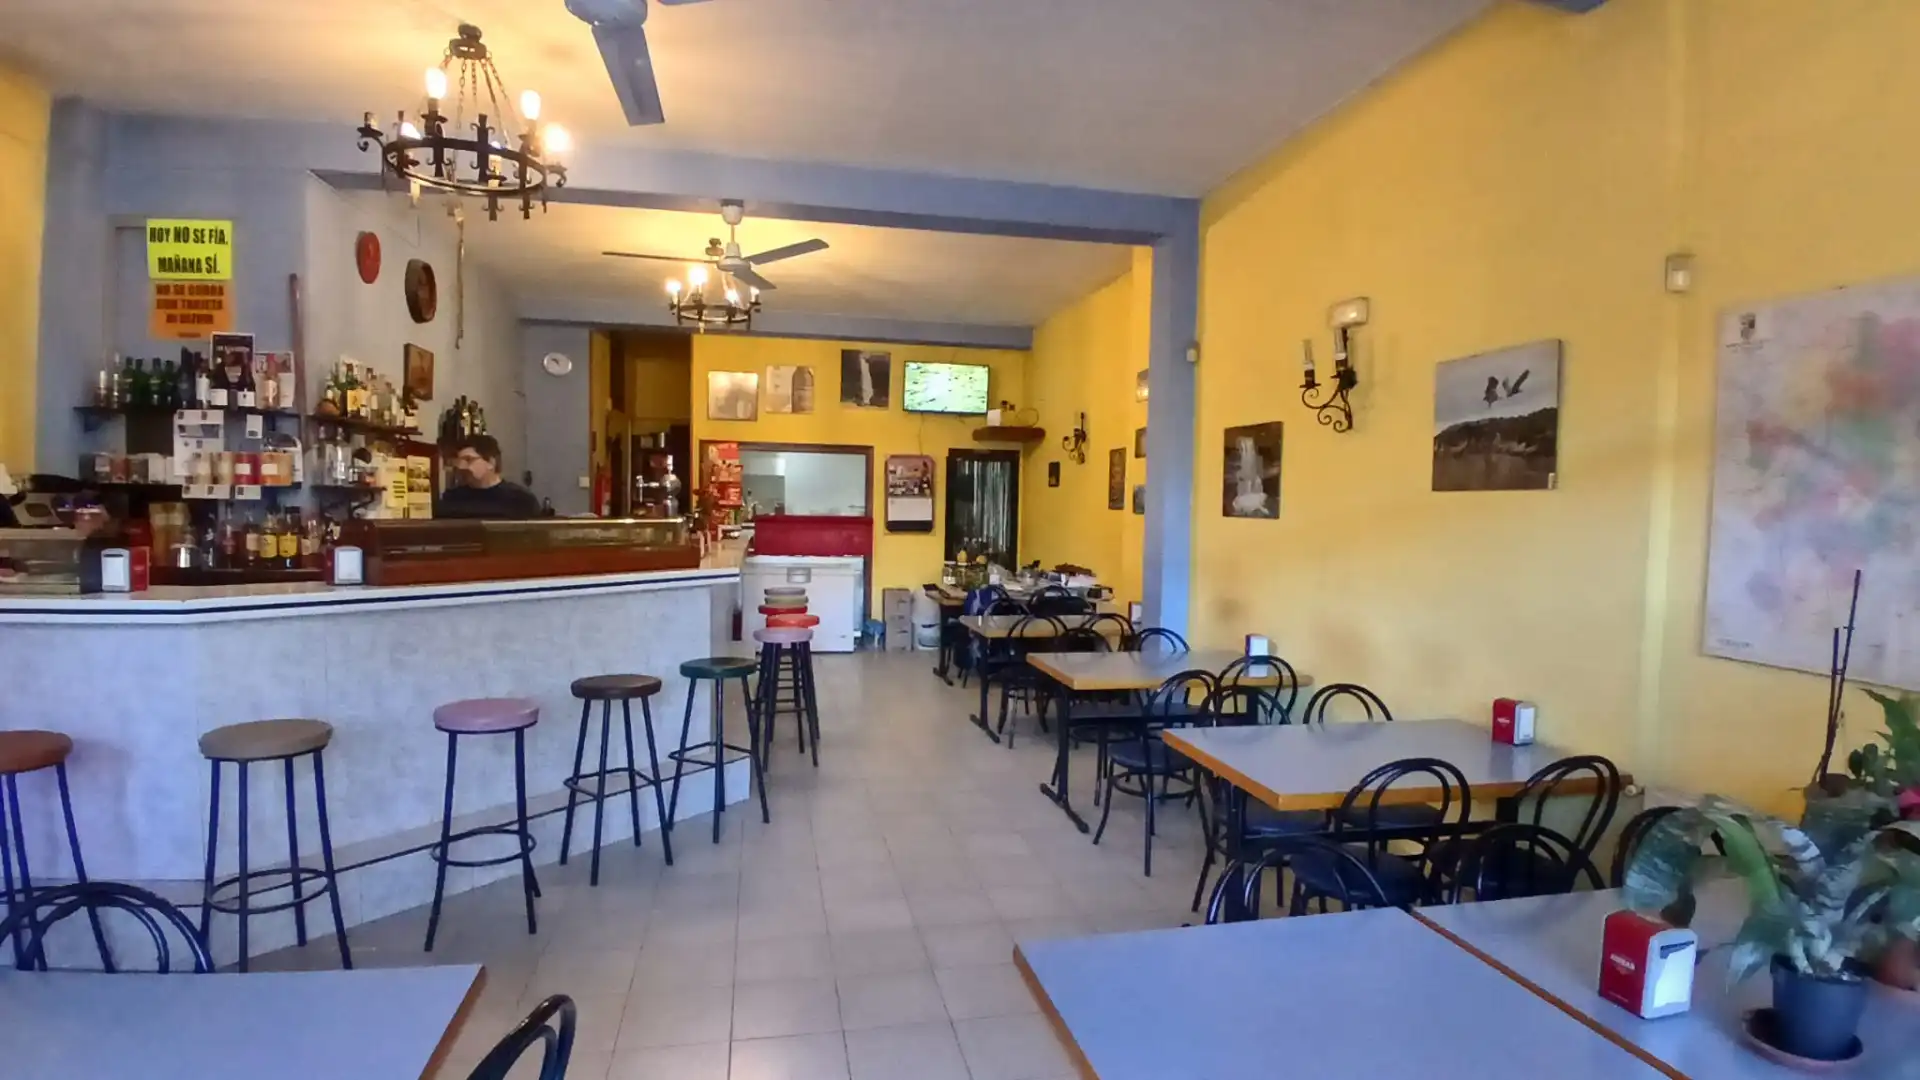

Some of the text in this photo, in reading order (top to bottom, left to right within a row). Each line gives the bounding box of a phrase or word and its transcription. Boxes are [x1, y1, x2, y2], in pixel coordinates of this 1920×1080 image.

[149, 226, 171, 243] HOY
[173, 226, 190, 244] NO
[192, 227, 206, 244] SE
[157, 253, 203, 274] MAÑANA
